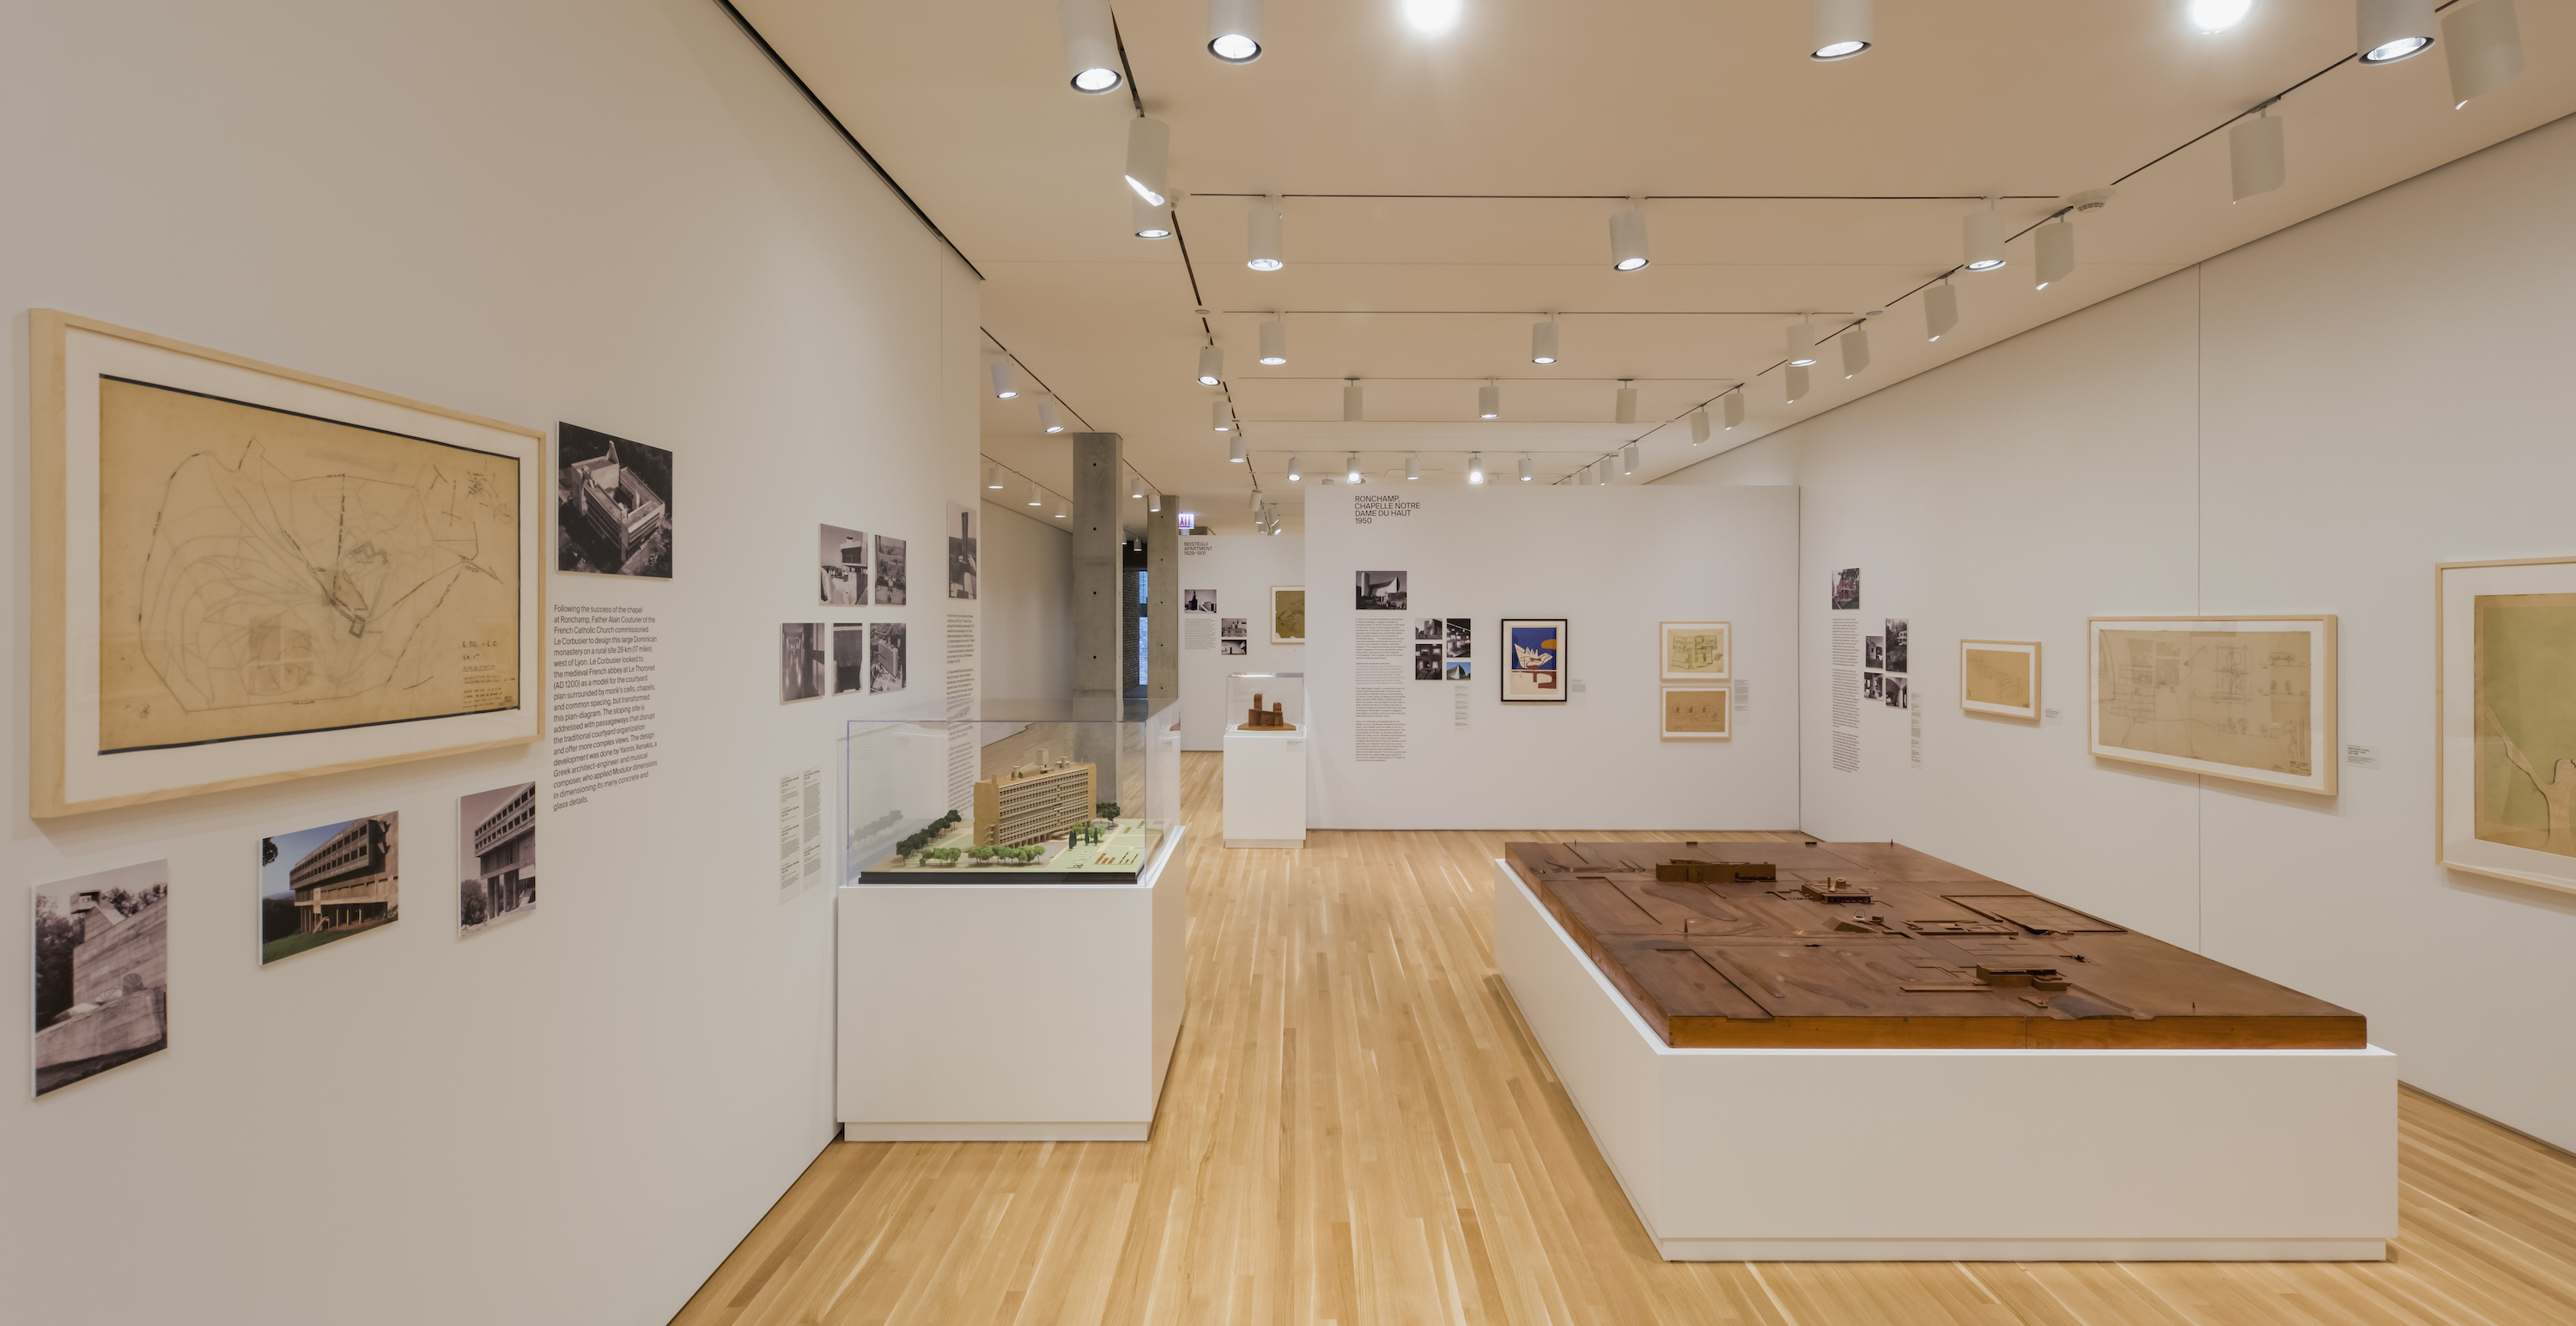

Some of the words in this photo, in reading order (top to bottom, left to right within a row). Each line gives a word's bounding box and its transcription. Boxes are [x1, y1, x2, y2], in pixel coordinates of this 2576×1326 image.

[554, 605, 580, 614] Following
[560, 616, 591, 624] Ronchamp,
[554, 648, 583, 656] monastery
[574, 659, 588, 667] Lyon.
[564, 669, 588, 677] medieval
[553, 681, 564, 690] (AD
[554, 693, 566, 701] plan
[567, 689, 598, 698] surrounded
[590, 699, 612, 708] spacing,
[621, 694, 650, 703] transformed
[565, 711, 602, 722] plan-diagram.
[553, 723, 583, 733] addressed
[595, 718, 629, 728] passageways
[564, 732, 591, 742] traditional
[591, 728, 616, 738] courtyard
[616, 724, 645, 734] organization
[593, 739, 615, 748] complex
[553, 753, 589, 766] development
[620, 745, 635, 753] Yannis
[635, 742, 654, 750] Xenakis,
[553, 767, 570, 777] Greek
[571, 759, 619, 773] architect-engineer
[630, 752, 648, 762] musical
[553, 778, 582, 788] composer,
[594, 769, 612, 780] applied
[613, 766, 632, 775] Modulor
[632, 761, 657, 771] dimensions
[560, 785, 596, 797] dimensioning
[618, 774, 639, 784] concrete
[553, 802, 569, 811] glass
[569, 797, 588, 806] details.
